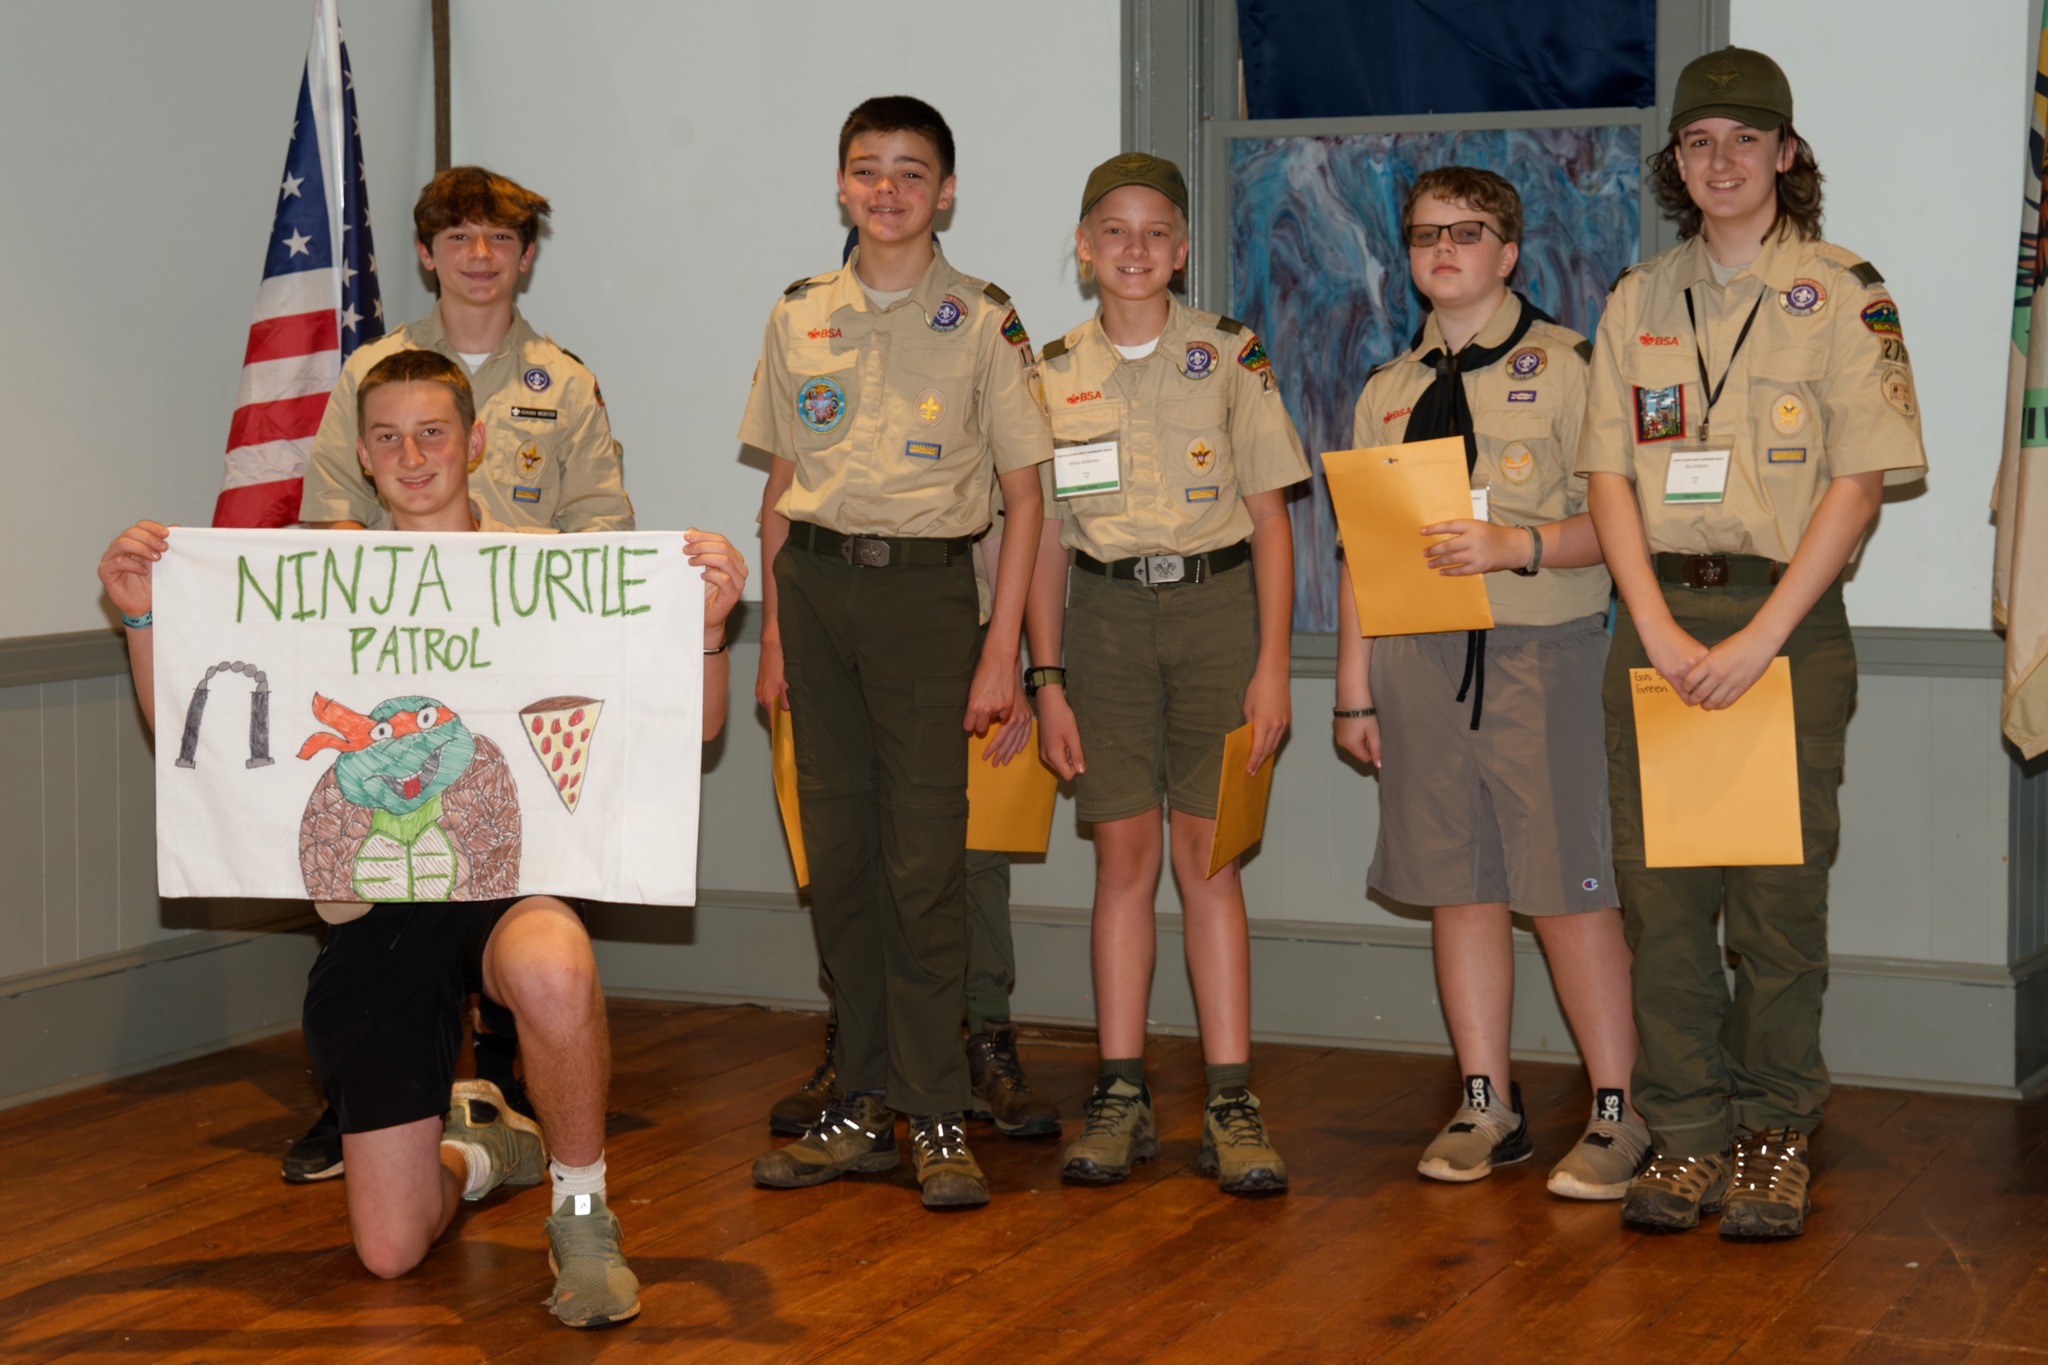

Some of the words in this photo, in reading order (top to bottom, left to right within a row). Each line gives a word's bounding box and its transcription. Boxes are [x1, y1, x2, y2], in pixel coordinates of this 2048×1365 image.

[821, 327, 842, 339] BSA
[1655, 335, 1679, 346] BSA
[1080, 390, 1102, 402] BSA
[236, 543, 453, 623] NINJA
[479, 544, 659, 626] TURTLE
[349, 625, 492, 675] PATROL
[1635, 683, 1669, 694] Green
